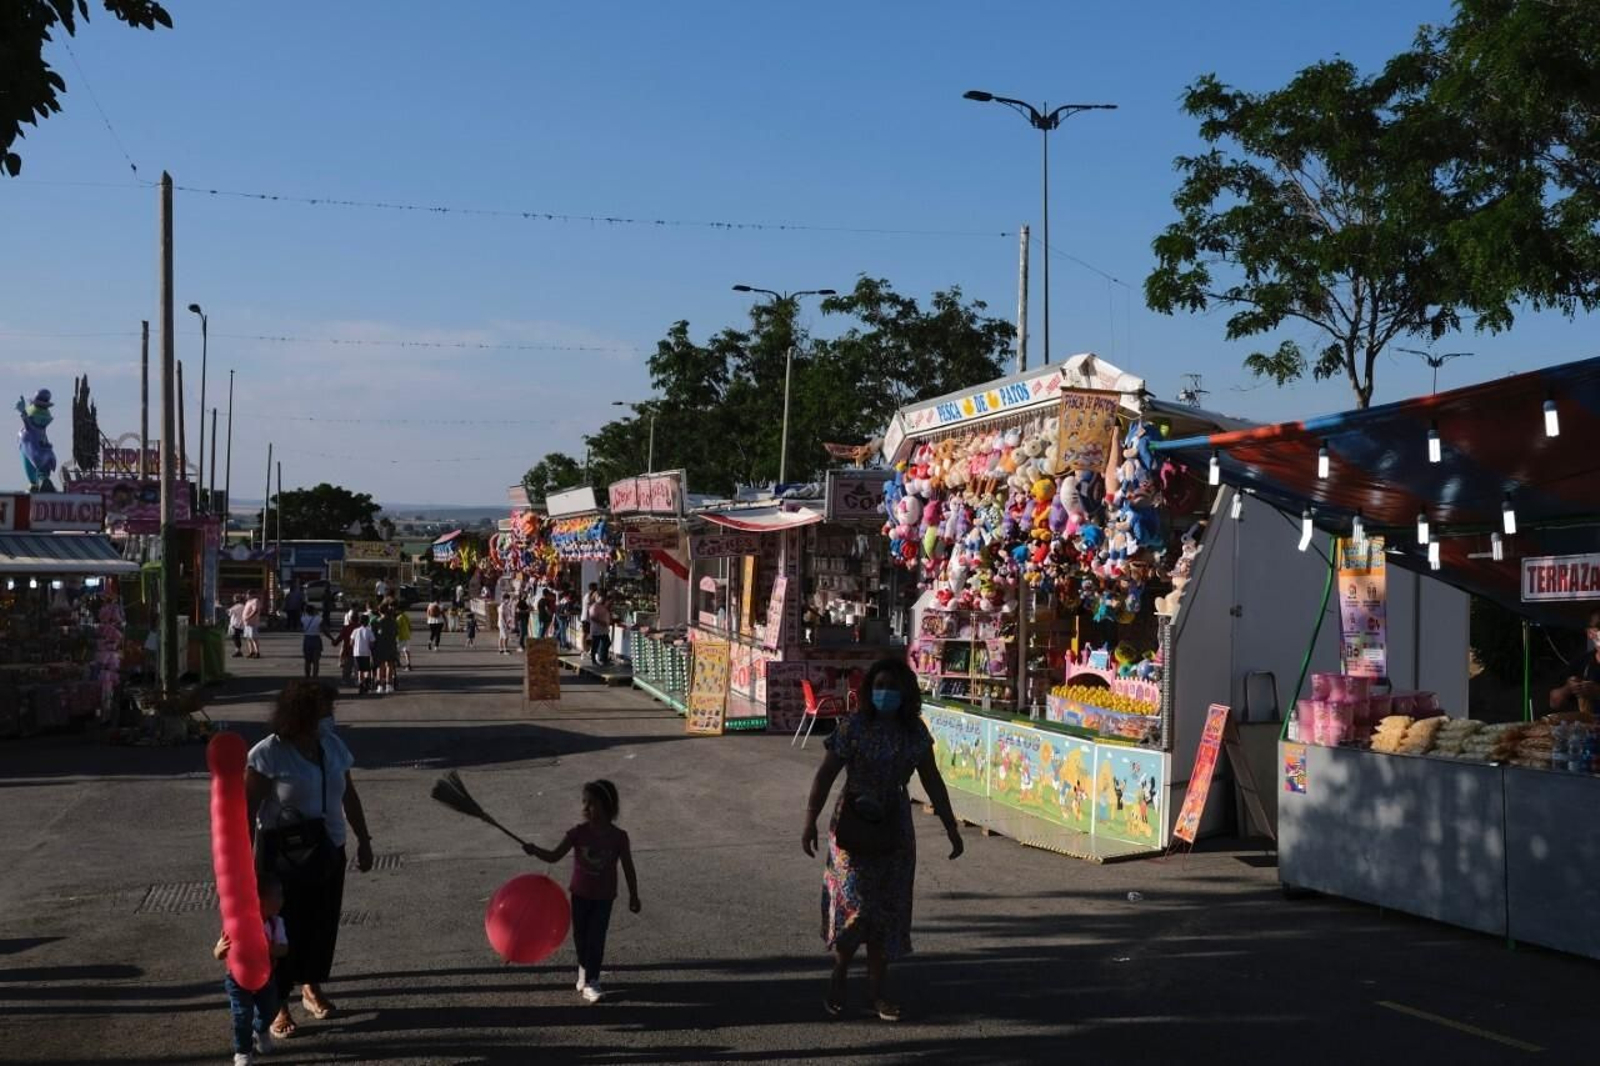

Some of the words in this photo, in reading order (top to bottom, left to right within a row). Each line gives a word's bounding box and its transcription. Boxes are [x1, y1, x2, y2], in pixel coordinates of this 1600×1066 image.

[937, 401, 963, 424] PESCA
[974, 395, 988, 413] DE
[999, 382, 1031, 407] PATOS
[1527, 563, 1600, 594] TERRAZA
